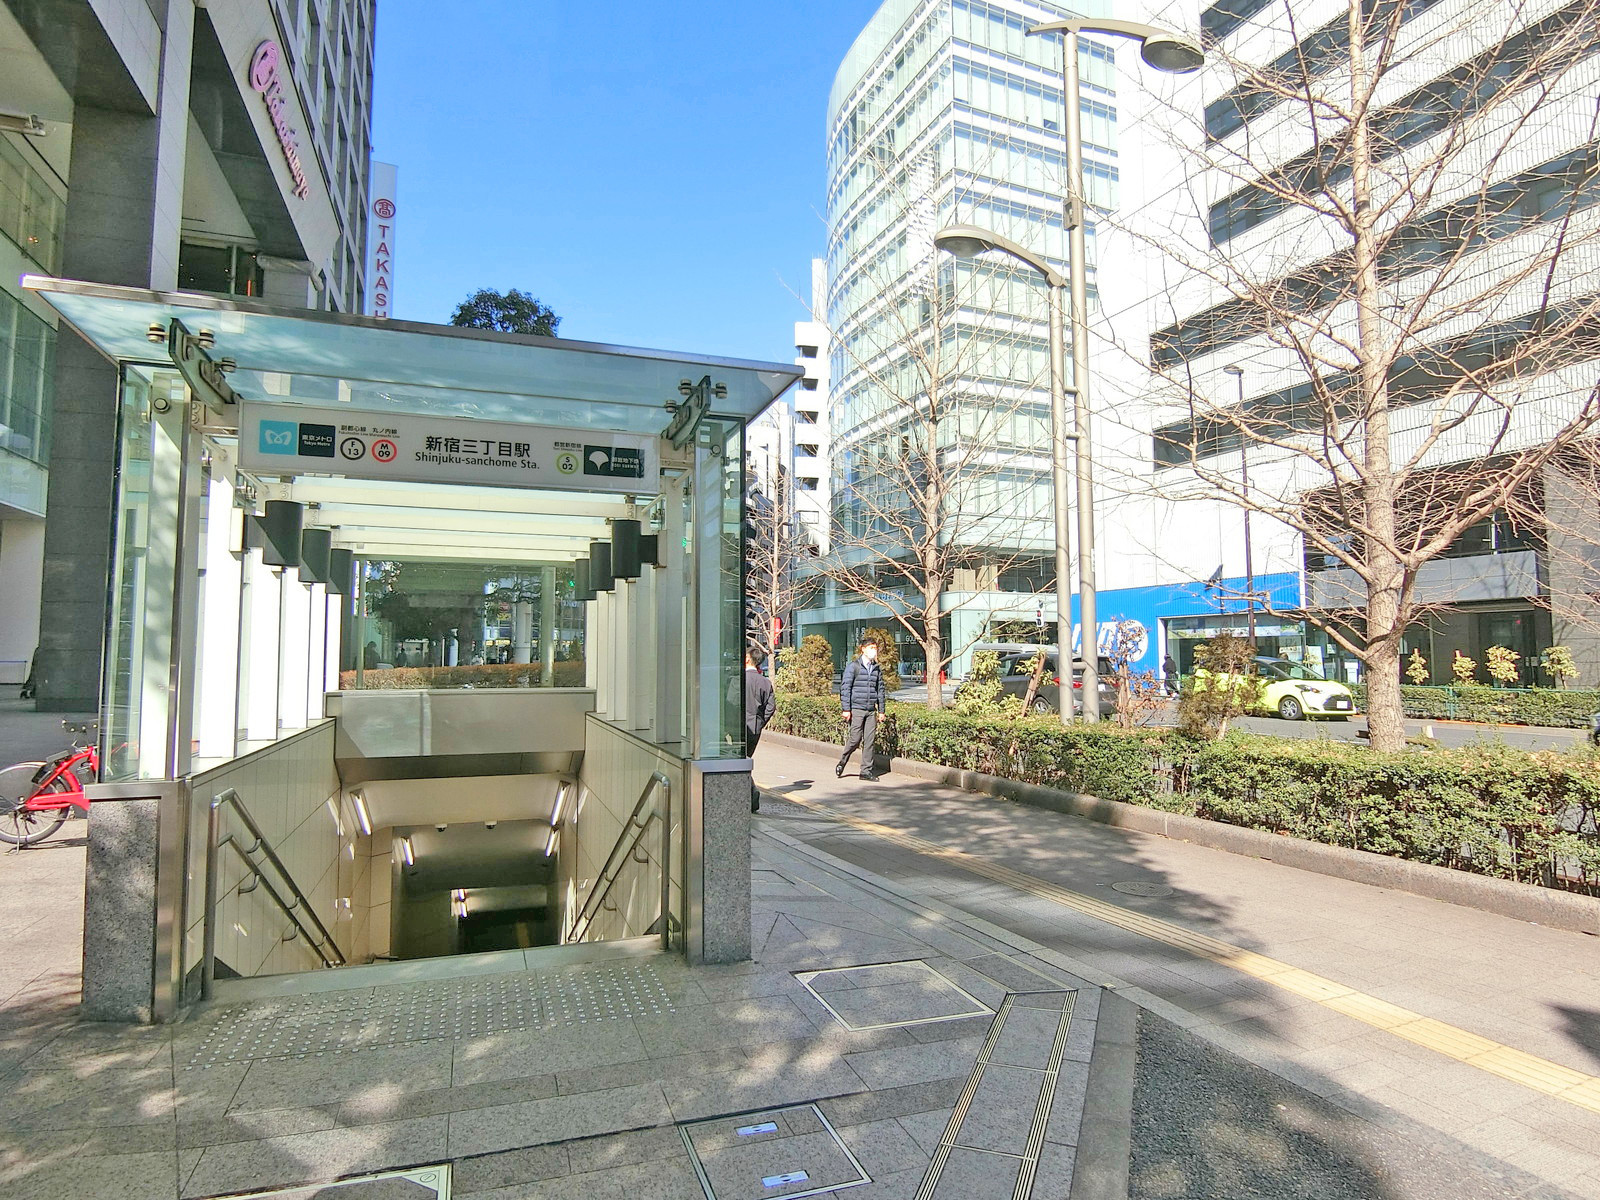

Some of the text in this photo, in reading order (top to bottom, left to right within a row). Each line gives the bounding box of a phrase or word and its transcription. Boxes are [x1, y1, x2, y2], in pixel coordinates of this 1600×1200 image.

[302, 434, 333, 443] 東京メトロ
[425, 435, 531, 458] 新宿三丁目駅
[347, 448, 359, 456] 13
[378, 450, 391, 458] 09
[415, 451, 540, 470] Shinjuku-sanchome Sta.
[562, 463, 573, 471] 02
